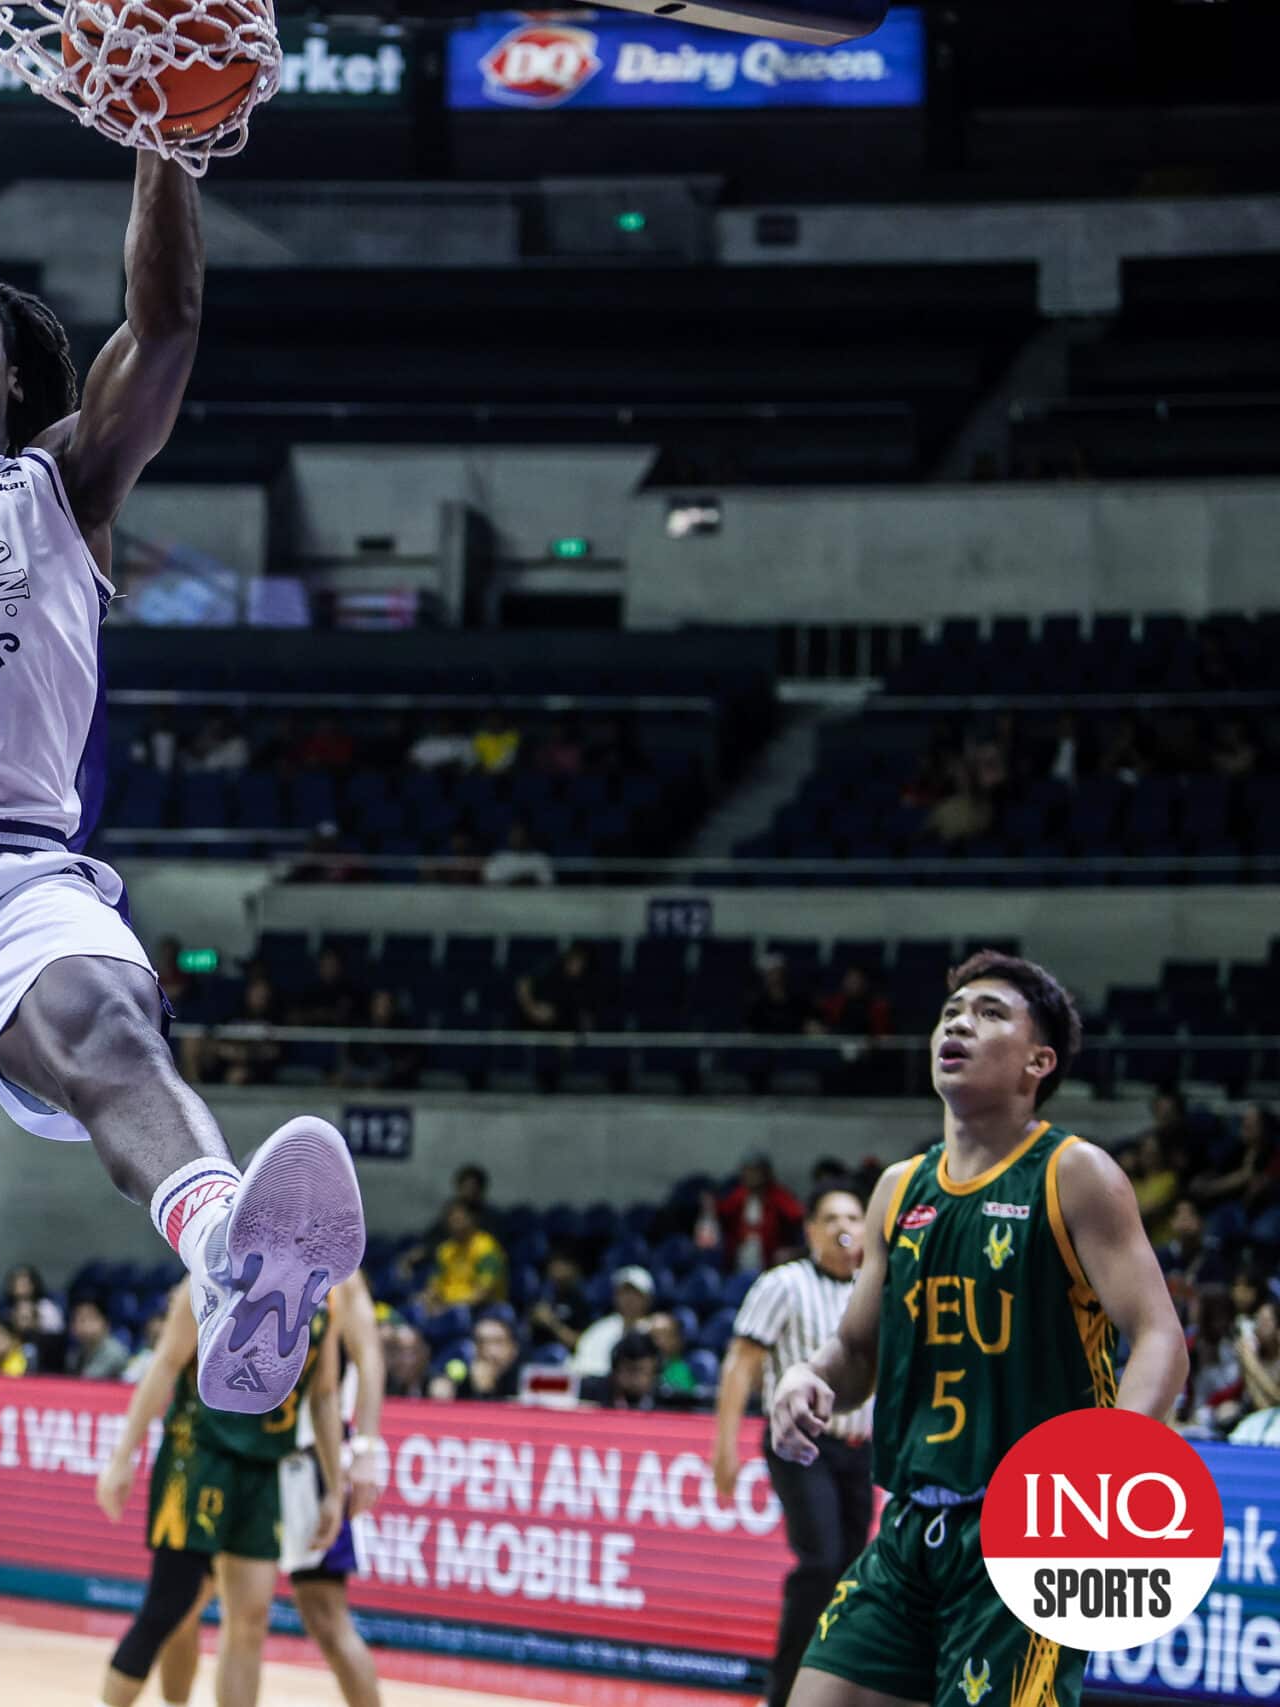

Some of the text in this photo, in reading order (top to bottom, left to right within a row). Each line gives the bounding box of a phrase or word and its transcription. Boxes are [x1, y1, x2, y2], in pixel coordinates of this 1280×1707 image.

[505, 42, 582, 84] DQ
[615, 42, 885, 91] Dairy Queen
[349, 1116, 405, 1150] 112
[926, 1368, 966, 1443] 5
[396, 1433, 533, 1514] OPEN
[539, 1443, 622, 1522] AN
[434, 1517, 646, 1611] MOBILE.
